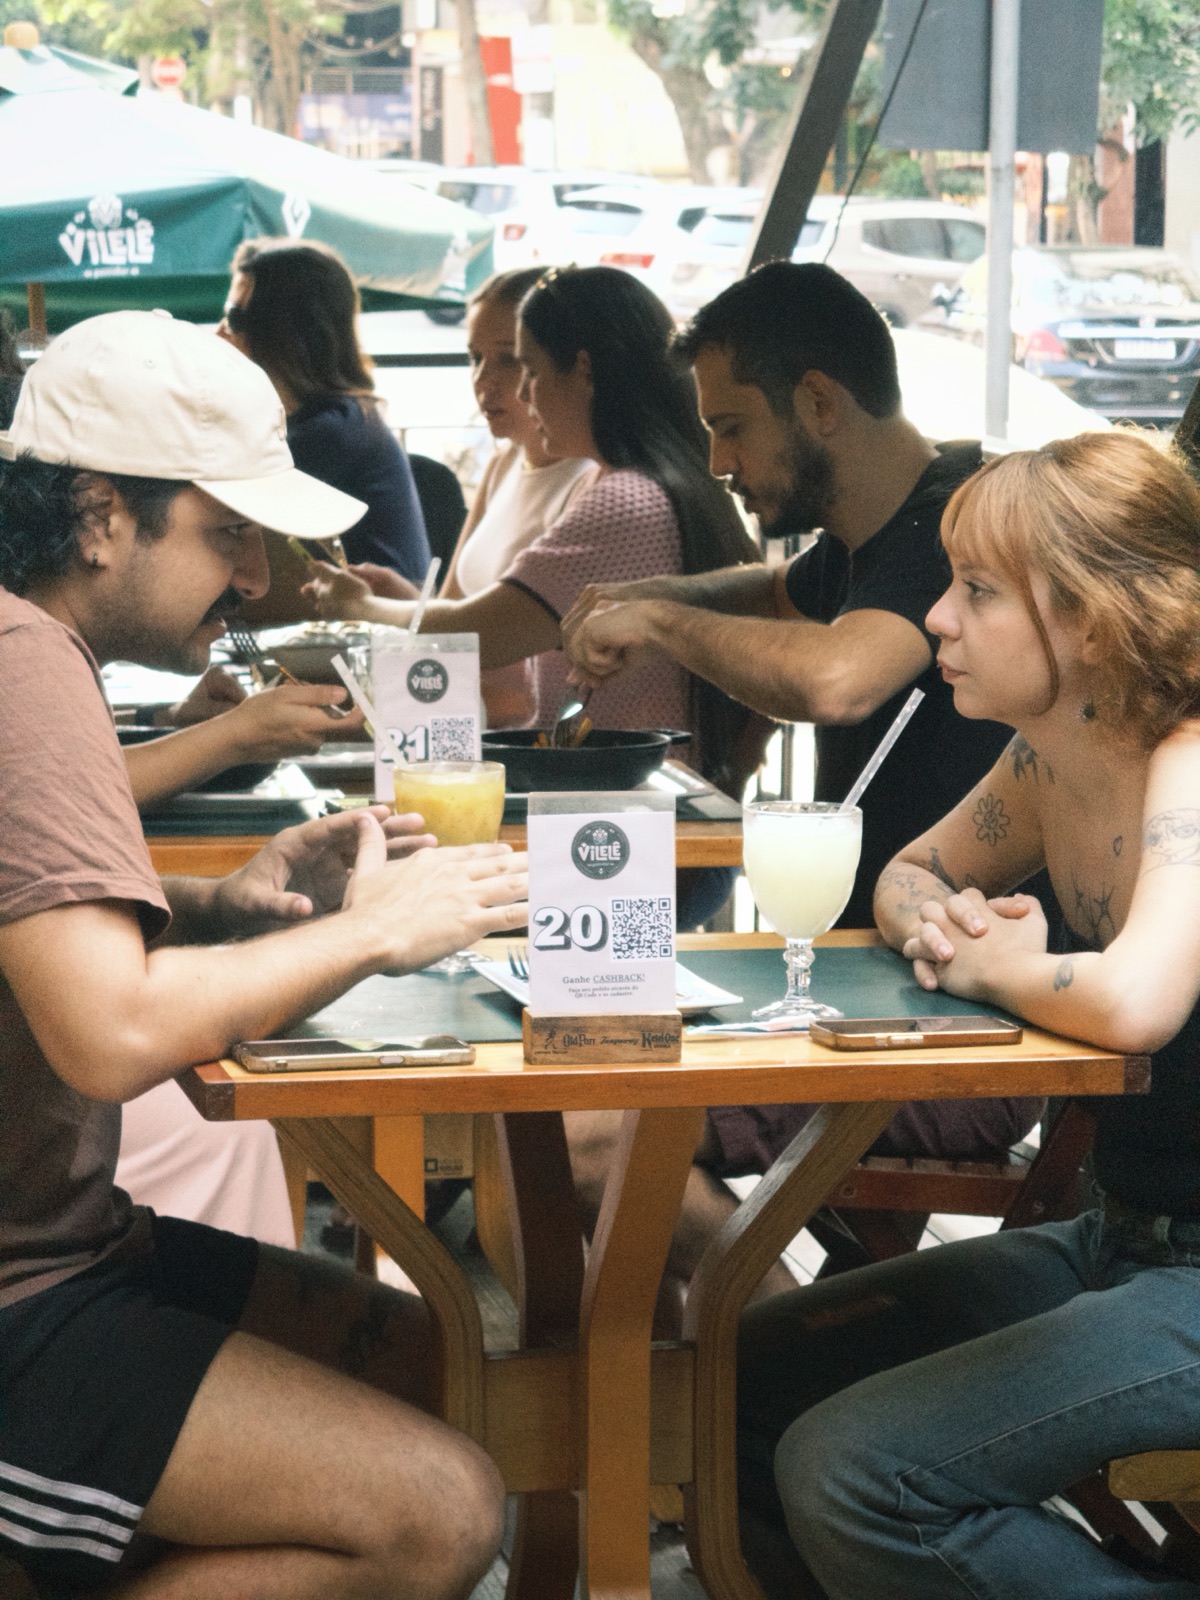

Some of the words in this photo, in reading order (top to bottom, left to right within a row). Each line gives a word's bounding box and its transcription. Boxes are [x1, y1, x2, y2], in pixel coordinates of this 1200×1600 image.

[533, 904, 610, 952] 20
[562, 975, 590, 984] Ganhe
[593, 973, 645, 983] CASHBACK!
